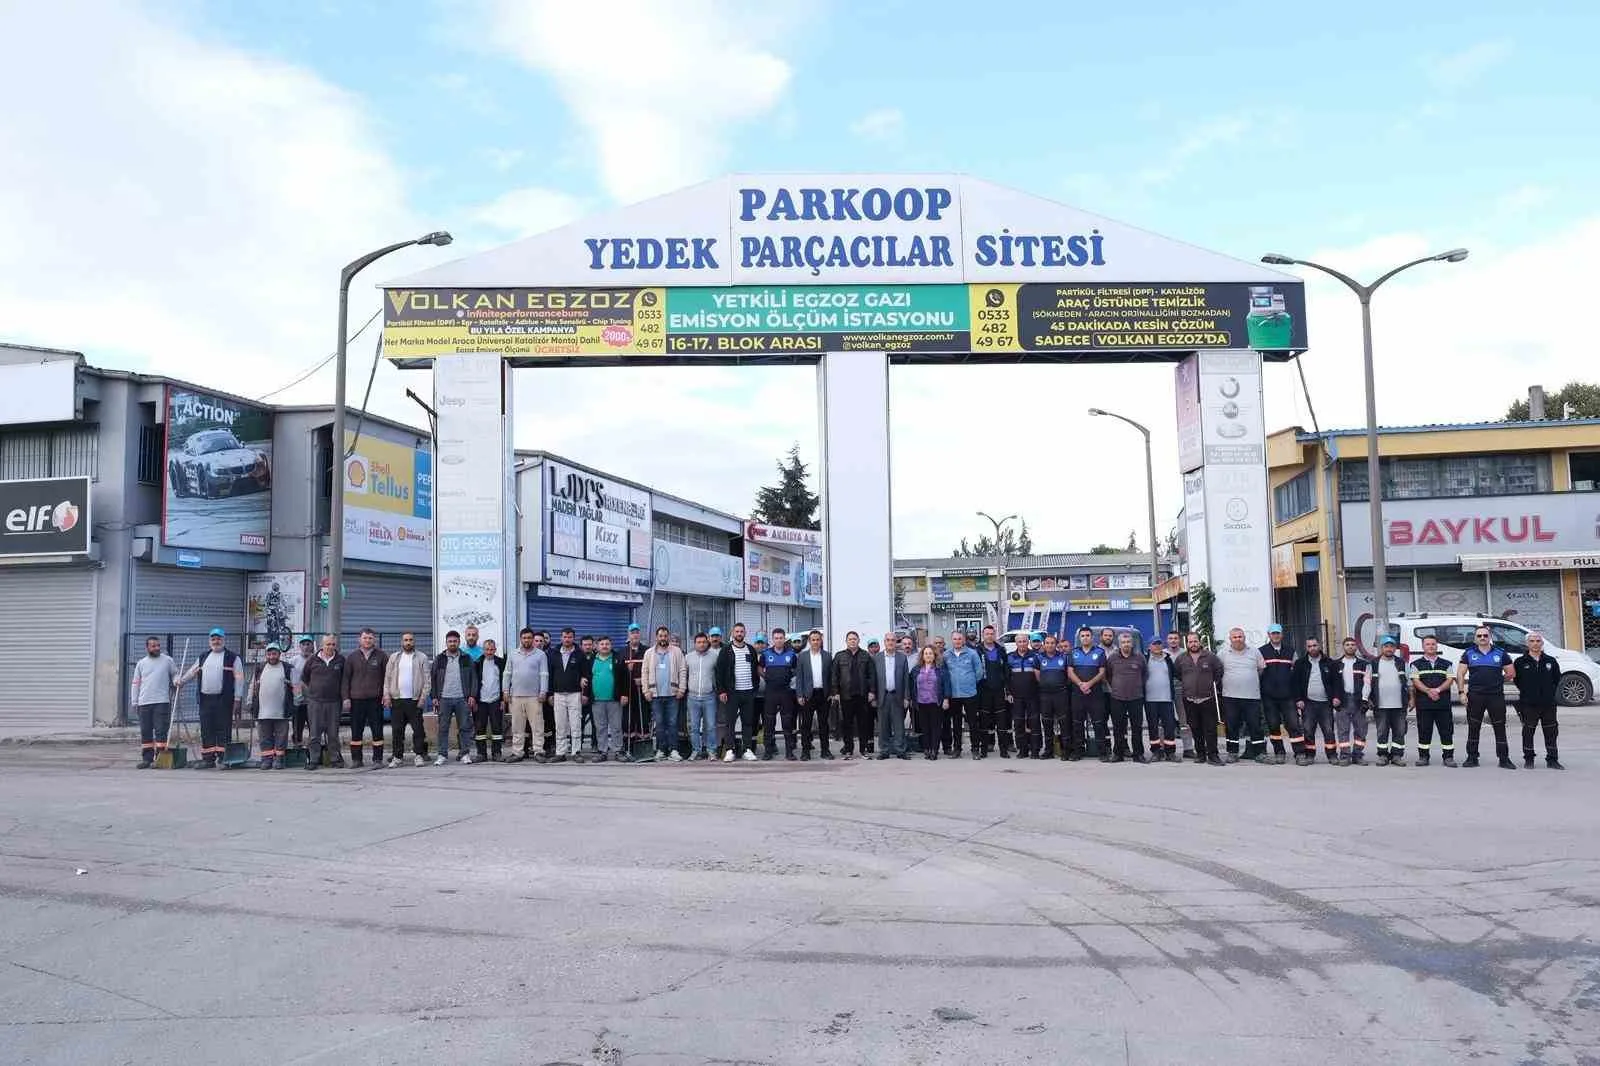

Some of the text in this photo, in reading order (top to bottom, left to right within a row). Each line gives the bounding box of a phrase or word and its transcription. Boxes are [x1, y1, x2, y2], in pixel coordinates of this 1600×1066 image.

[739, 188, 952, 222] PARKOOP
[584, 229, 1105, 276] YEDEK PARÇACILAR SİTESİ
[1056, 287, 1205, 296] PARTİKÜL FİLTRESİ (DPF) KATALİZÖR
[388, 290, 631, 315] VOLKAN EGZOZ
[712, 290, 911, 308] YETKİLİ EGZOZ GAZI
[1057, 295, 1205, 309] ARAÇ ÜSTÜNDE TEMİZLİK
[638, 310, 661, 320] 0533
[978, 310, 1010, 320] 0533
[1181, 309, 1231, 317] BOZMADAN)
[670, 308, 954, 330] EMİSYON ÖLÇÜM İSTASYONU
[505, 325, 525, 334] ÖZEL
[641, 324, 659, 333] 482
[982, 323, 1007, 333] 482
[1050, 319, 1215, 332] 45 DAKİKADA KESİN ÇÖZÜM
[427, 337, 450, 345] Model
[551, 336, 579, 346] Montaj
[580, 336, 600, 345] Dahil
[669, 336, 822, 350] 16-17. BLOK ARASI
[842, 333, 954, 342] www.volkanegzoz.com.tr
[976, 336, 1013, 347] 49 67
[1035, 335, 1090, 346] SADECE
[1097, 334, 1154, 345] VOLKAN
[637, 339, 663, 348] 49 67
[371, 473, 409, 501] Tellus
[6, 505, 52, 531] elf
[1389, 515, 1557, 545] BAYKUL
[241, 535, 265, 545] MOTUL
[1497, 559, 1562, 568] BAYKUL
